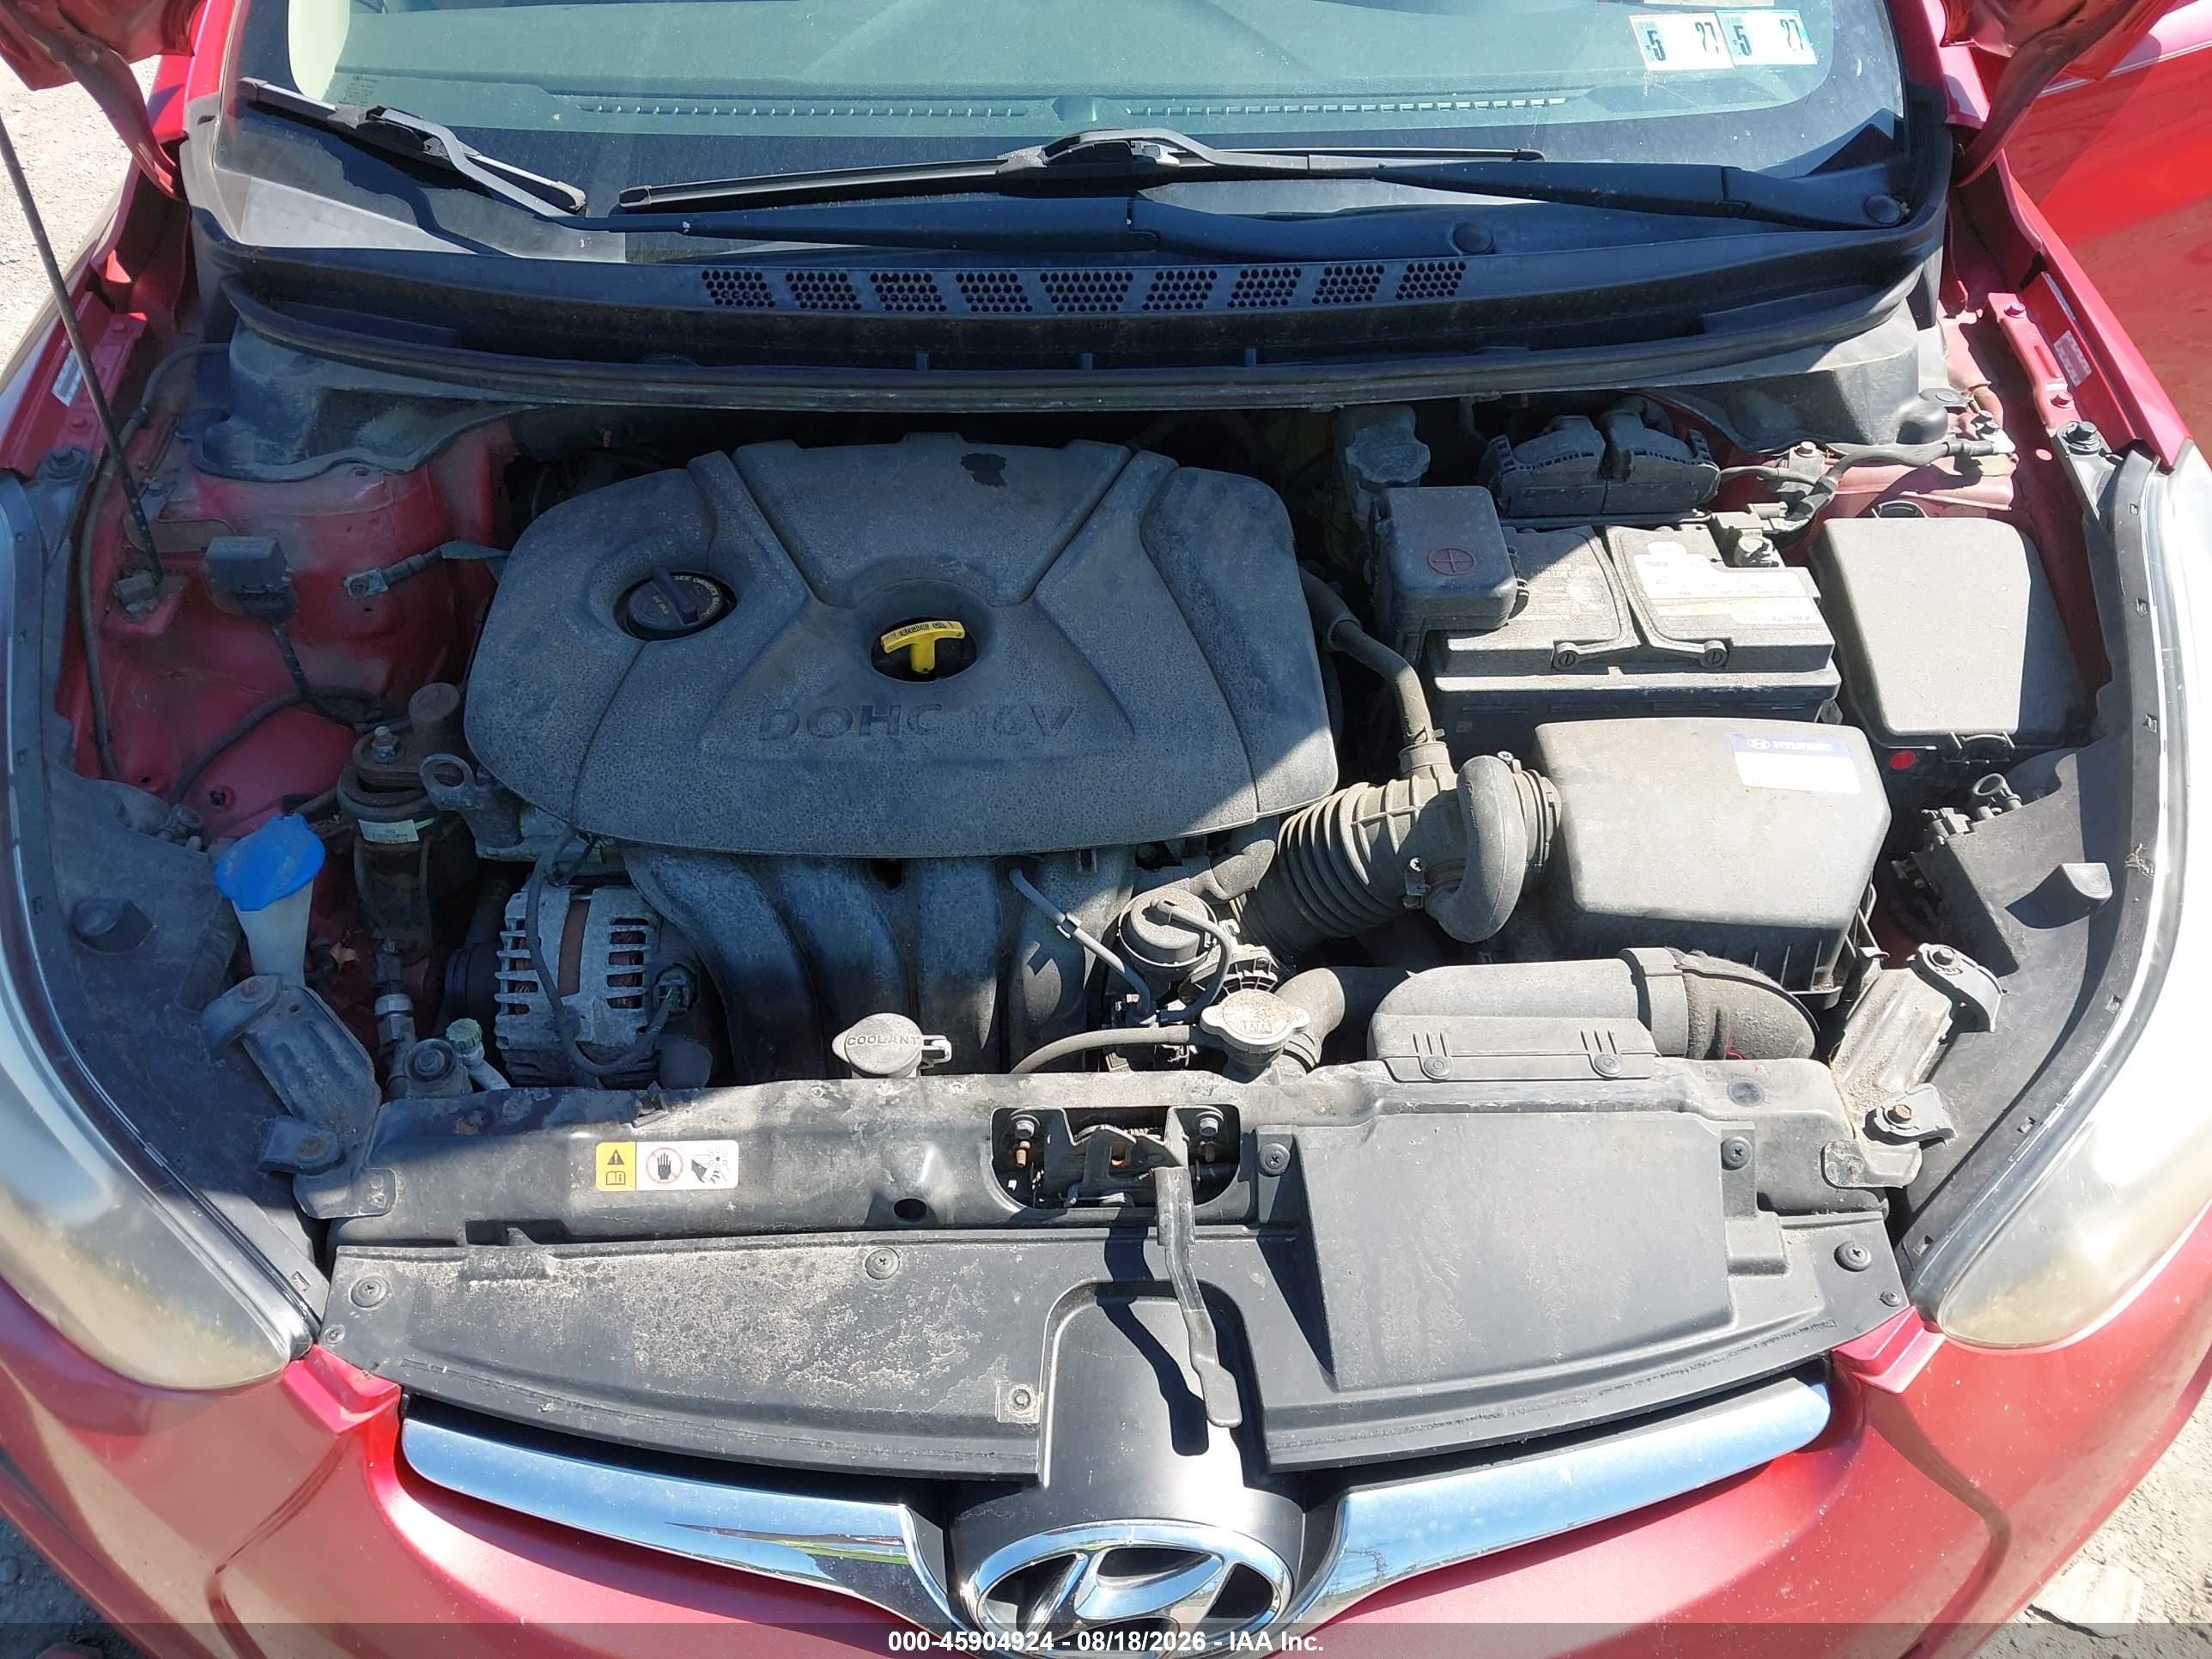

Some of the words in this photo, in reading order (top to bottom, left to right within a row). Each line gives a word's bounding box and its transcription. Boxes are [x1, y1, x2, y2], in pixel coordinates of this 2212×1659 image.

[1646, 29, 1666, 61] 5
[1733, 24, 1753, 57] 5
[899, 623, 930, 636] ENGINE
[757, 702, 942, 741] DOHC
[847, 1035, 920, 1046] COOLANT
